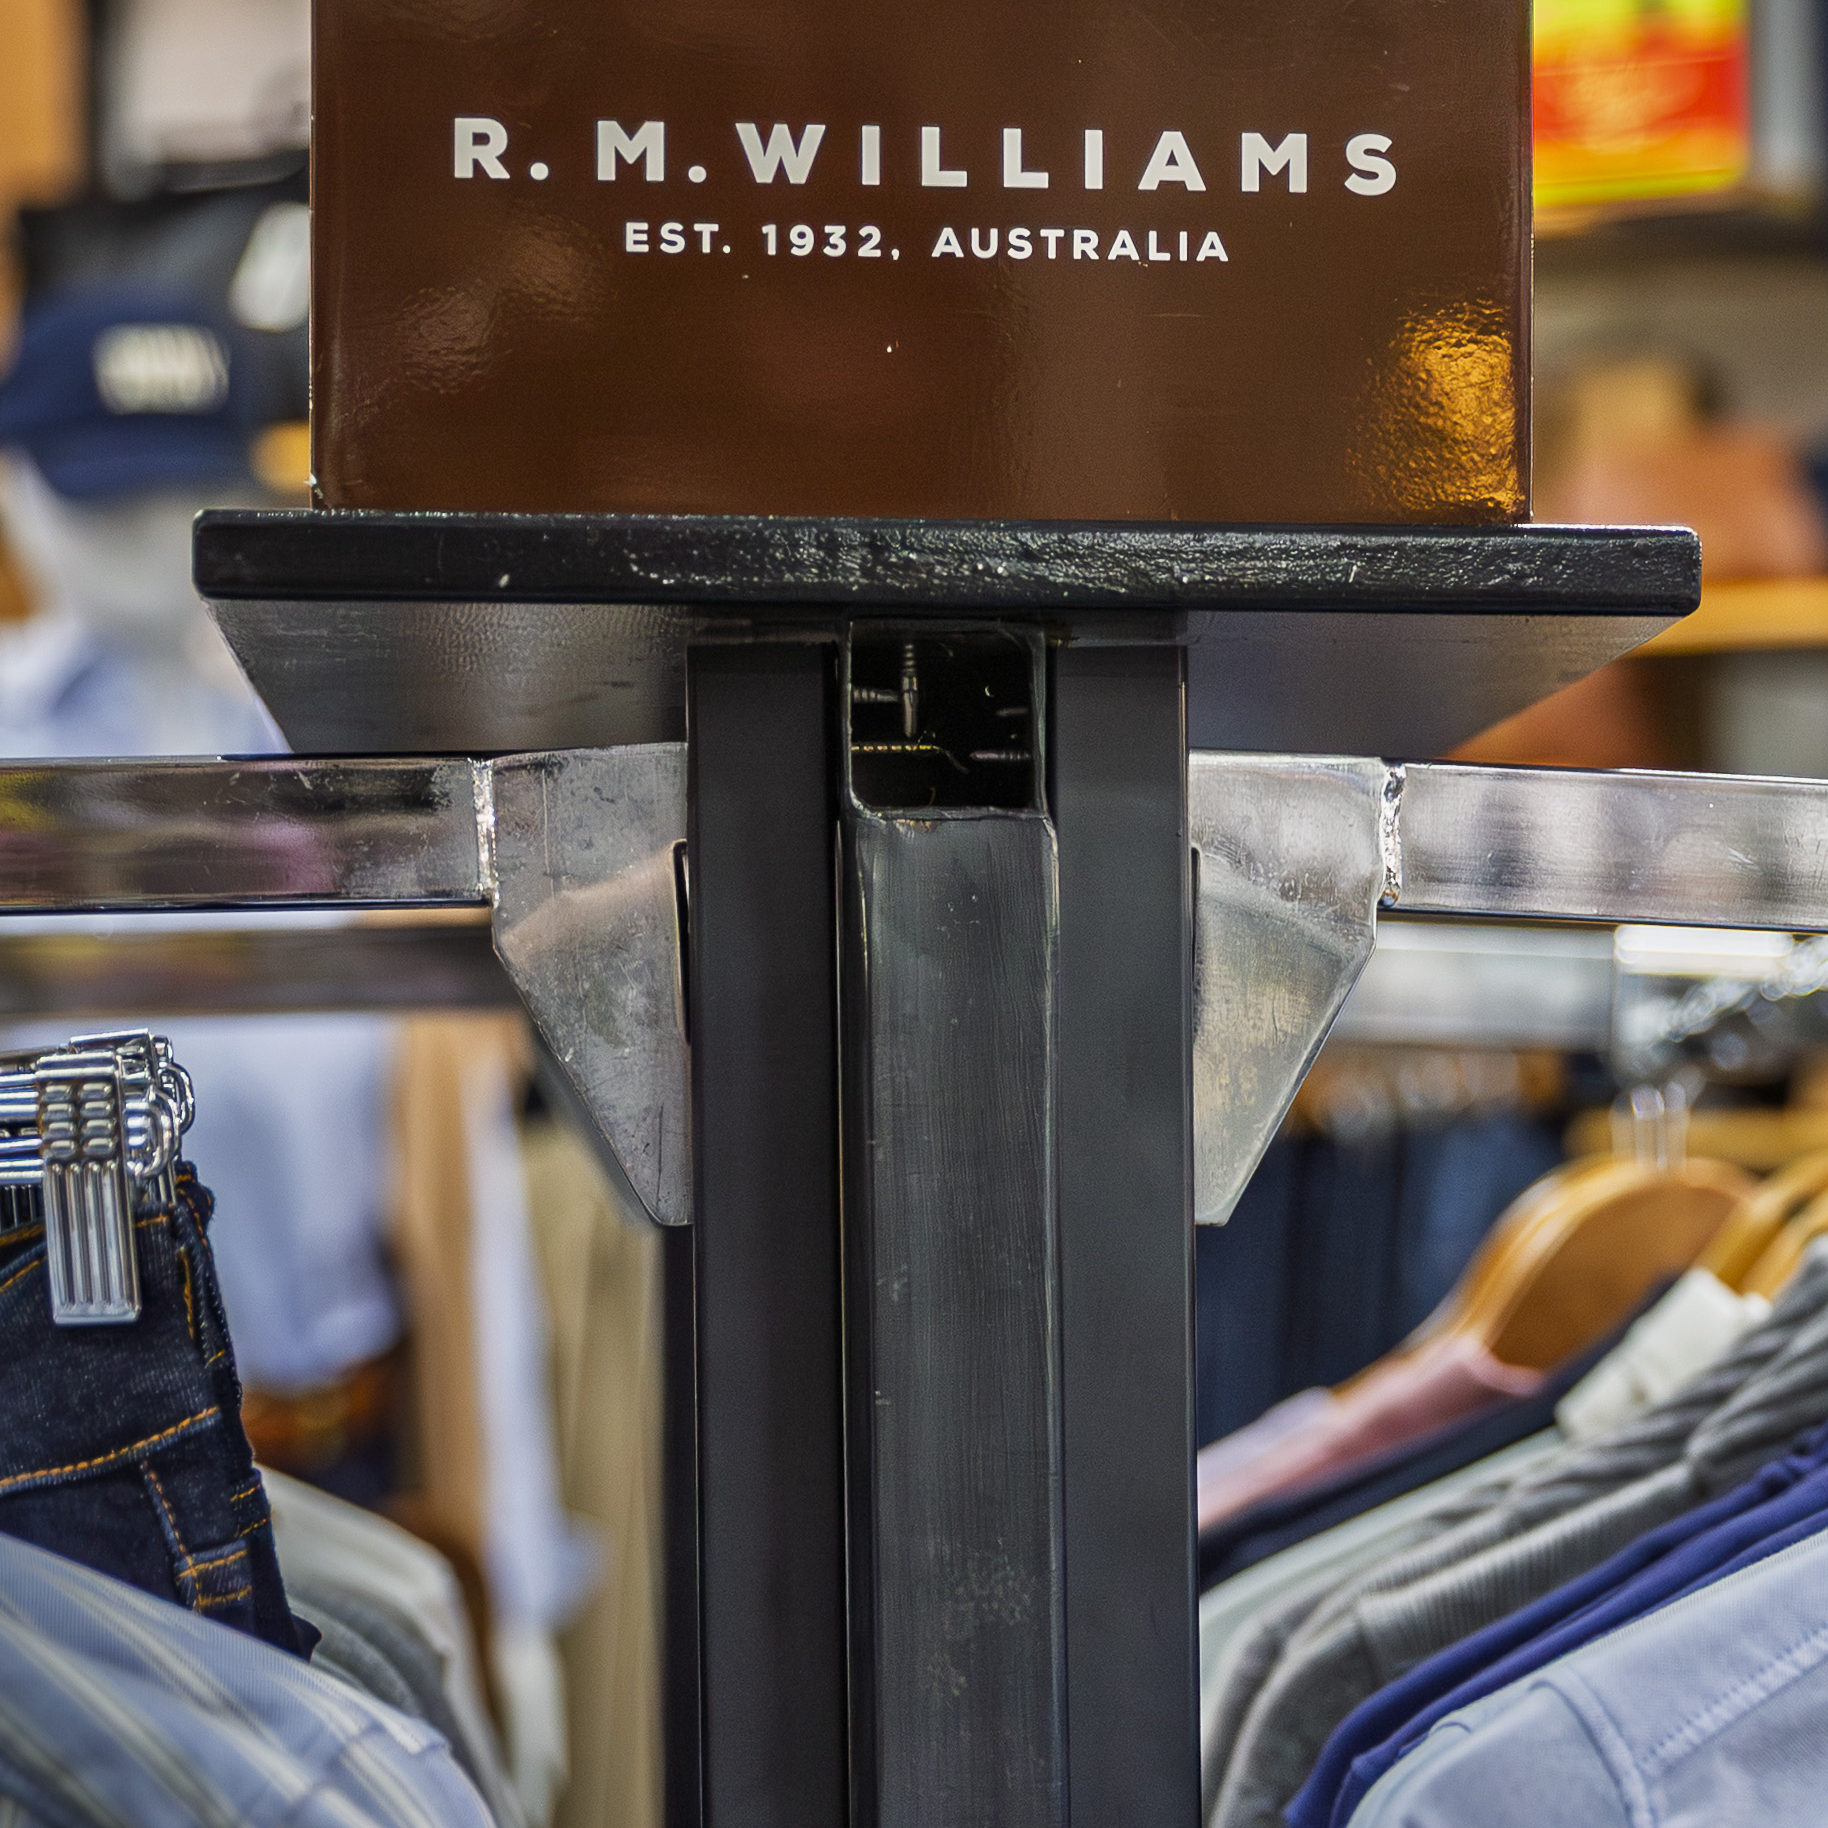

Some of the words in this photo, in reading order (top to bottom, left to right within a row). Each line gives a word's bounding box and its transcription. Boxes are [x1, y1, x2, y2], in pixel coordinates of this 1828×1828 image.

[625, 221, 733, 254] EST.
[761, 223, 900, 261] 1932,
[931, 227, 1230, 263] AUSTRALIA
